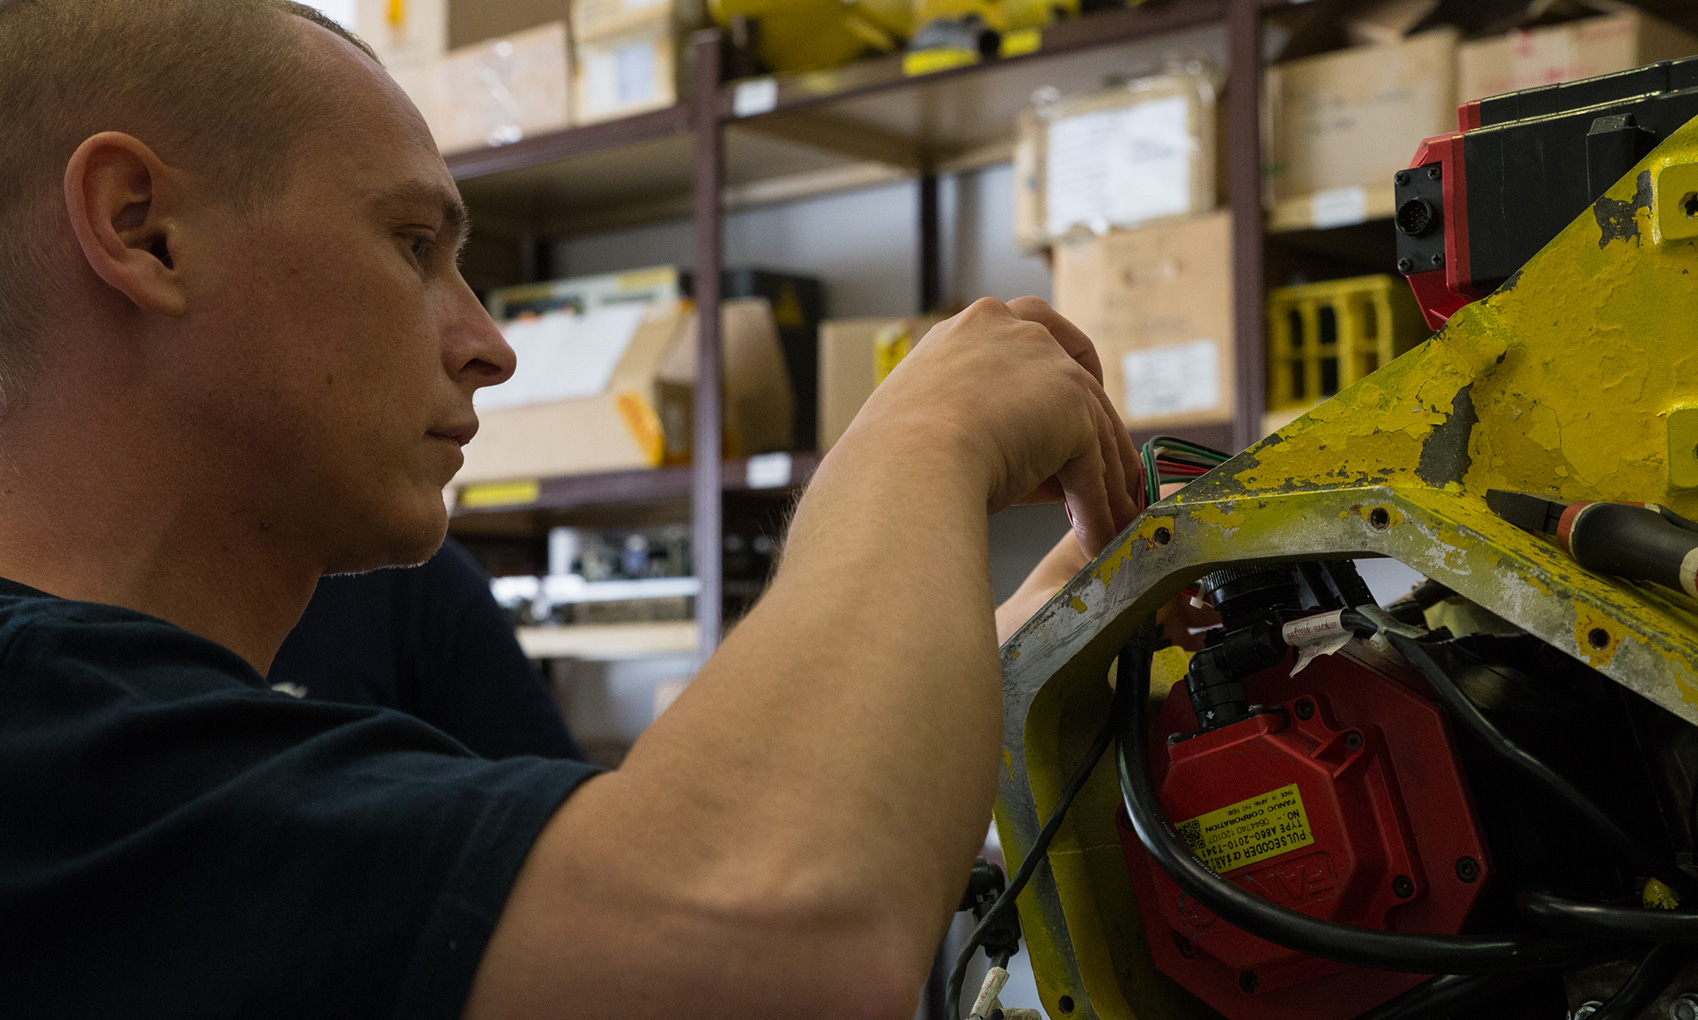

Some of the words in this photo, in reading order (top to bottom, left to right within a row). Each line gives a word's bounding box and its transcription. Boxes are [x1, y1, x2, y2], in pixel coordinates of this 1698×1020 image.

[1267, 798, 1296, 812] FANUC
[1205, 808, 1264, 833] CORPORATION
[1236, 817, 1270, 834] 0644740
[1280, 819, 1303, 833] TYPE
[1201, 826, 1277, 858] A860-2010-T341
[1208, 829, 1235, 844] 120107
[1243, 829, 1307, 859] PULSECODER
[1191, 856, 1221, 880] HITACHI
